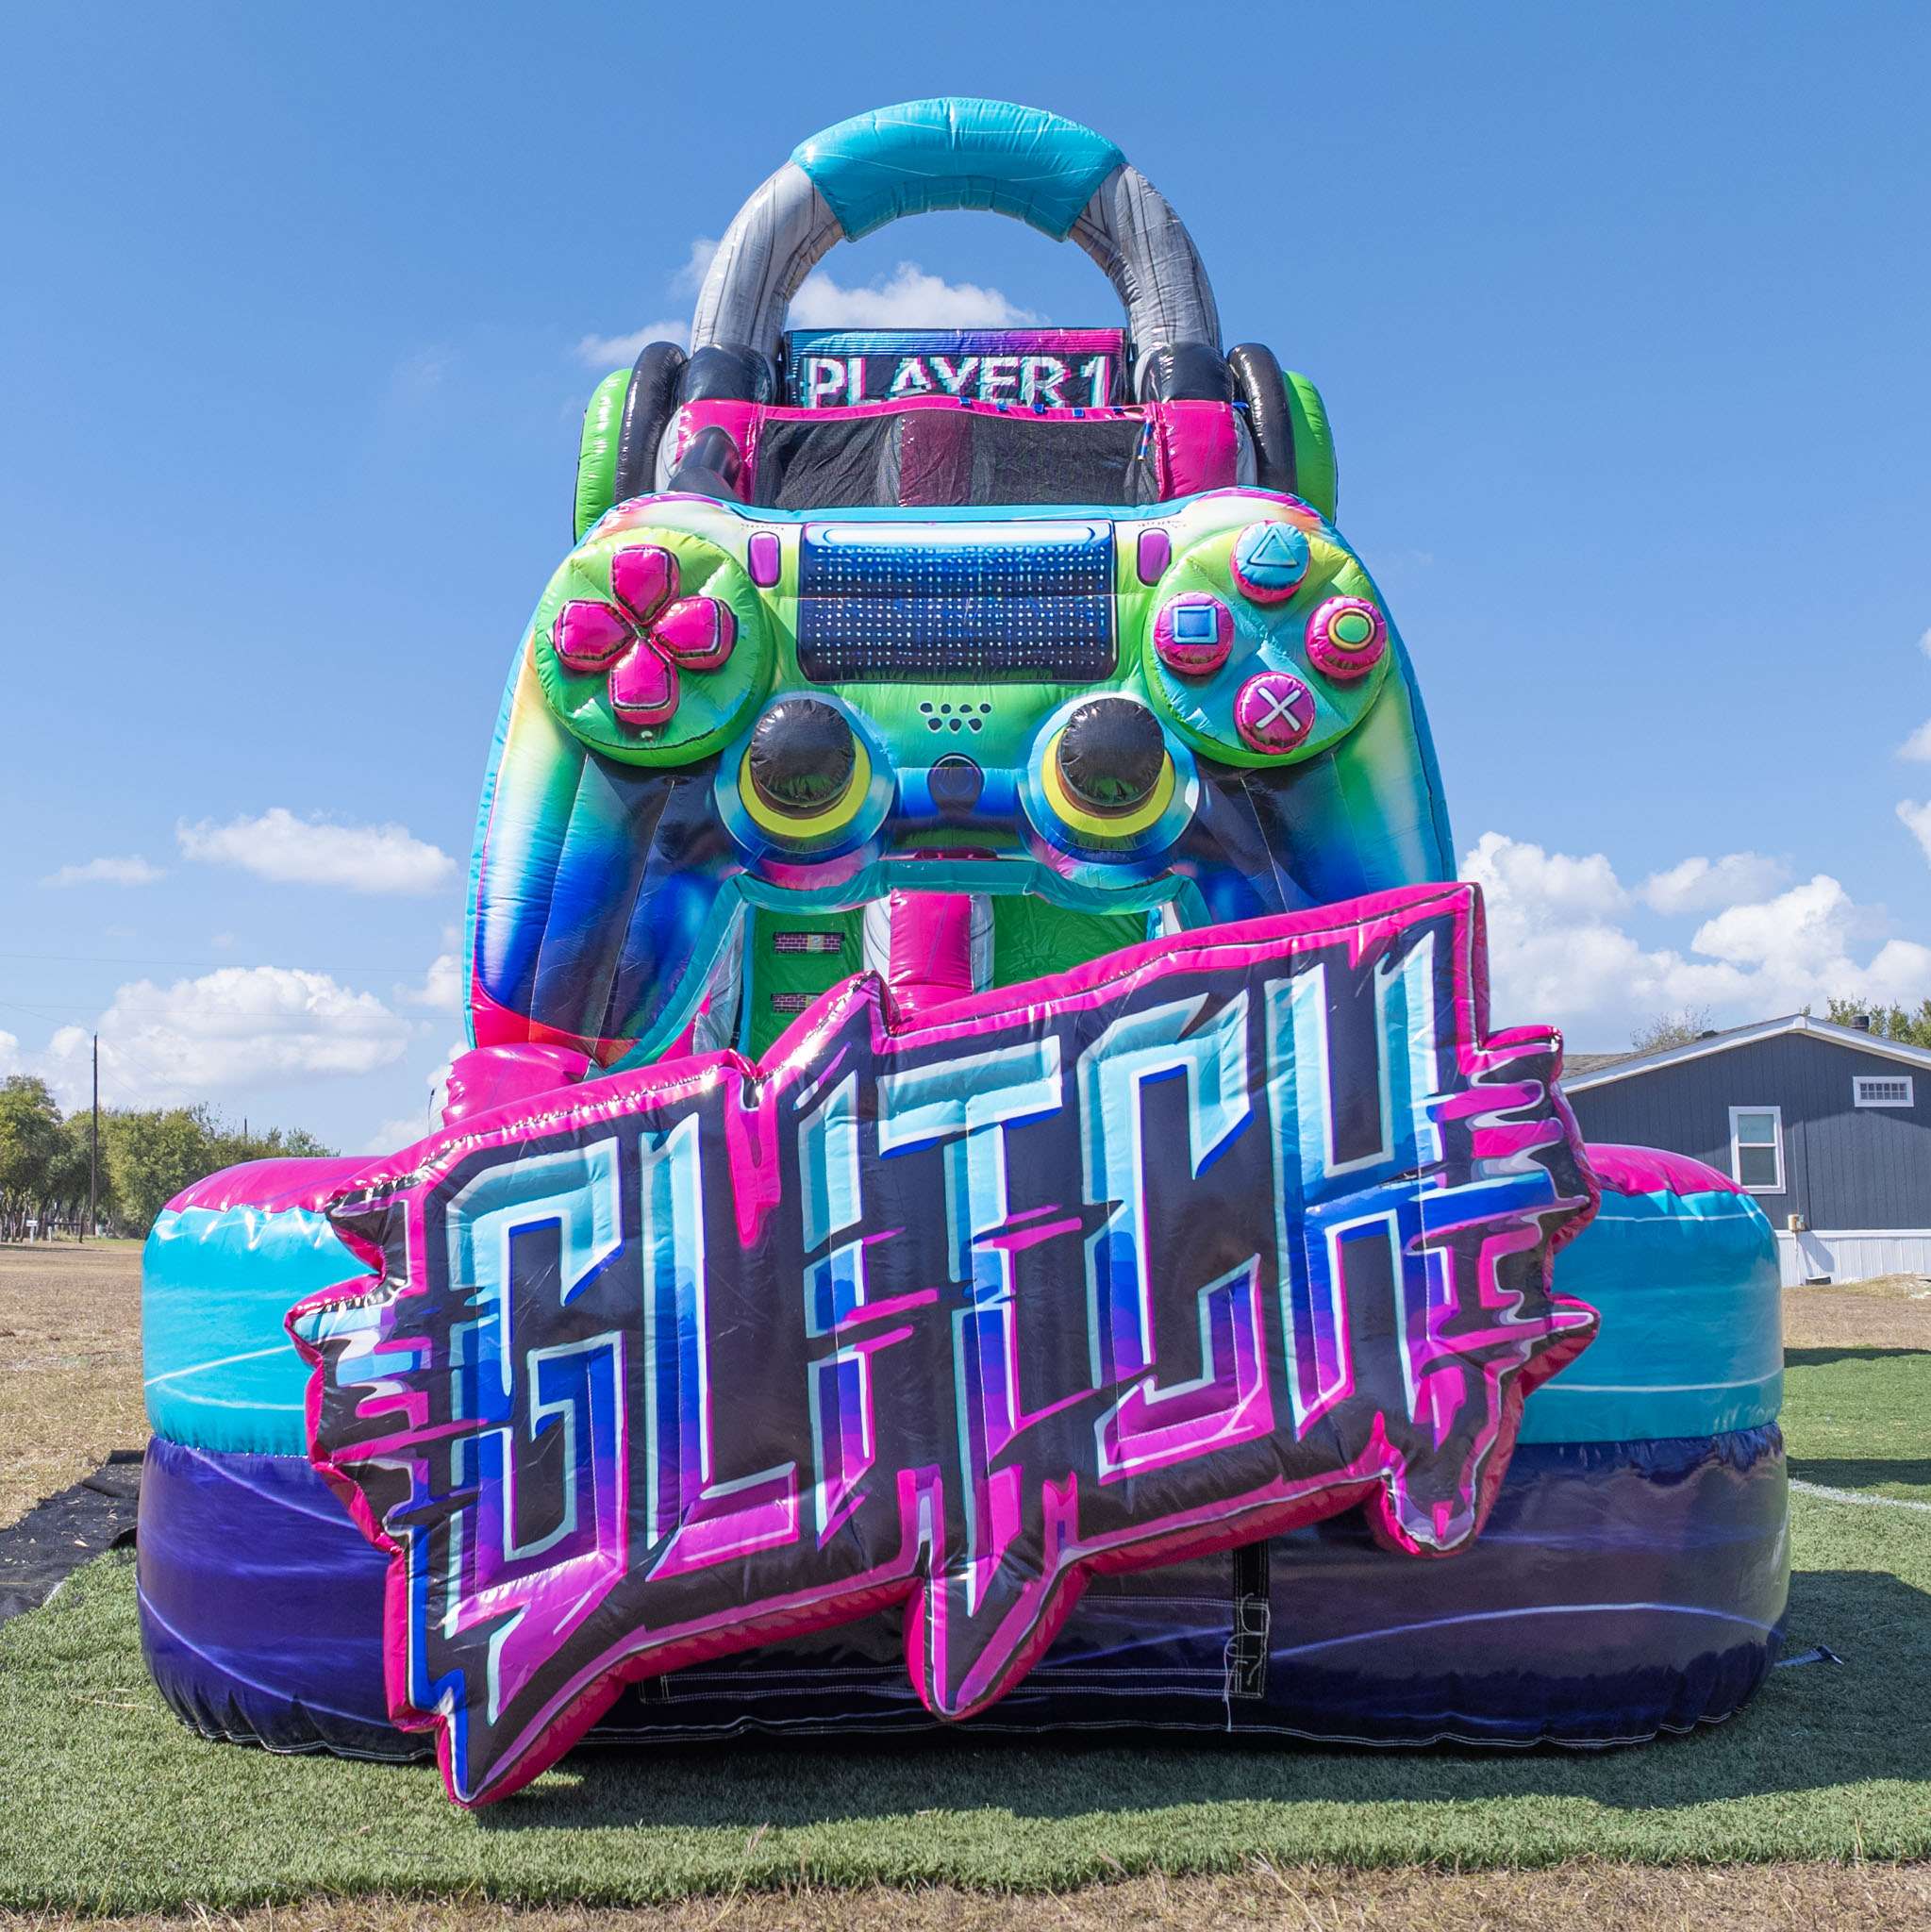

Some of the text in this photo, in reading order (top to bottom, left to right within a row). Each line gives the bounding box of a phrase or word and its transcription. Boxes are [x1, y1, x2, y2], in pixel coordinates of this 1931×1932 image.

[801, 355, 1110, 408] PLAYER 1
[441, 928, 1462, 1719] GLITCH
